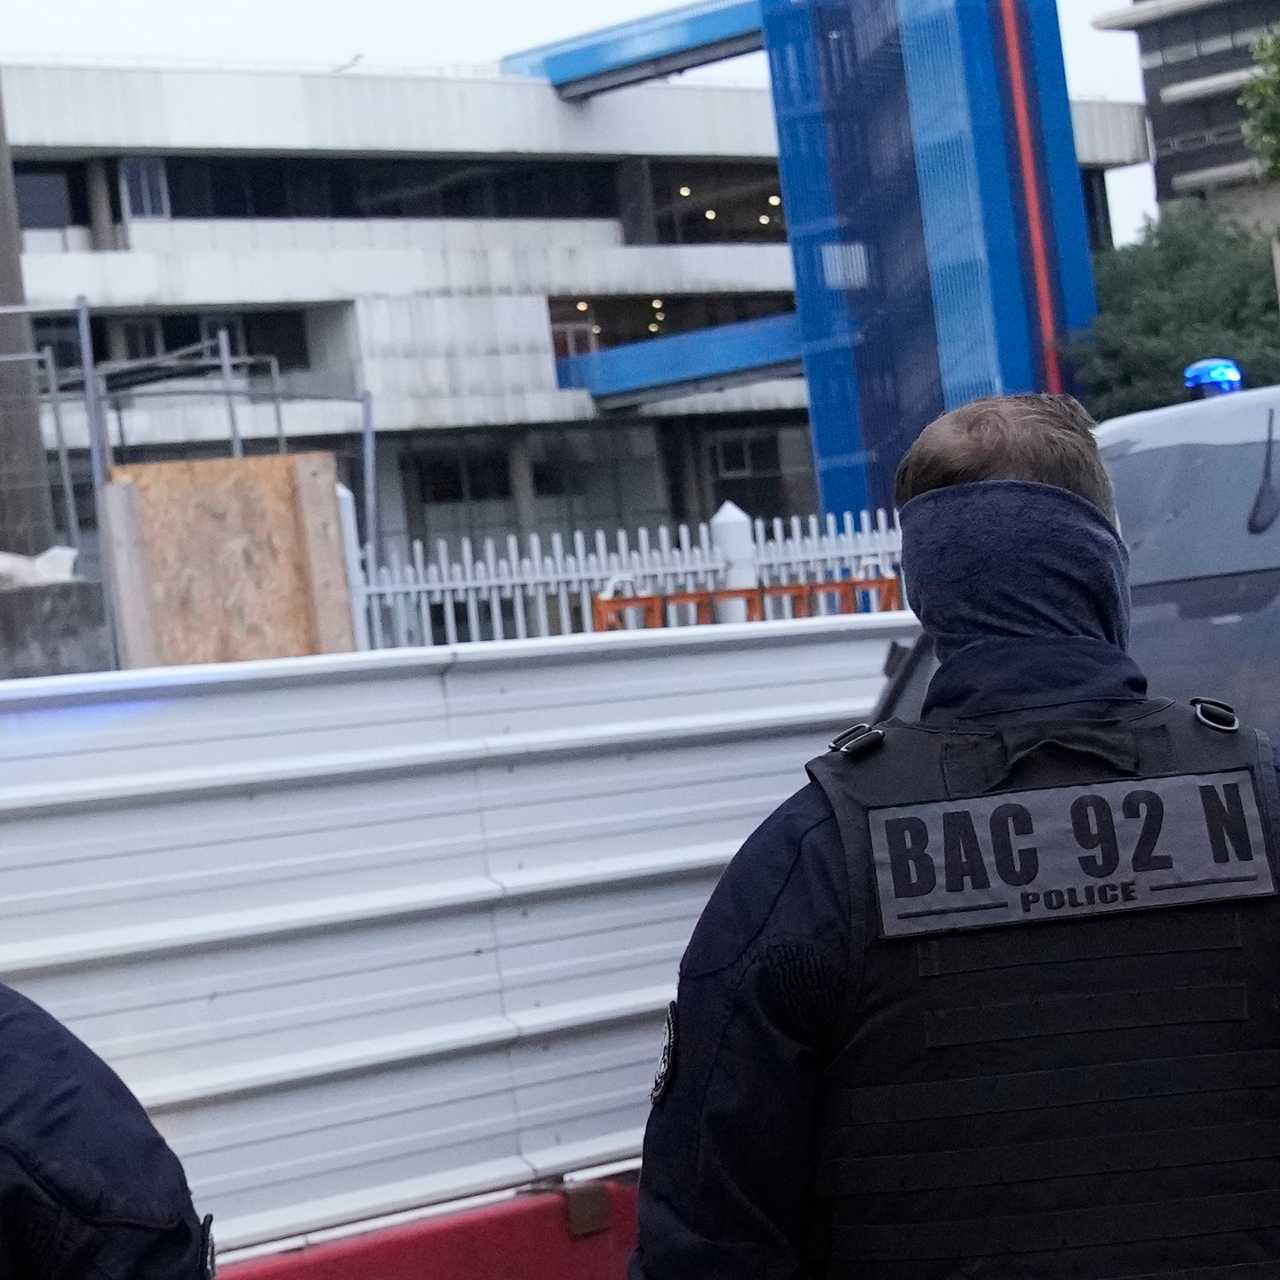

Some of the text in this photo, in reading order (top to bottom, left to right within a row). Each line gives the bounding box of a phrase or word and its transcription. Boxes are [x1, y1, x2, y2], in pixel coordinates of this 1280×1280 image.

[884, 782, 1254, 899] BAC 92 N
[1020, 880, 1139, 914] POLICE
